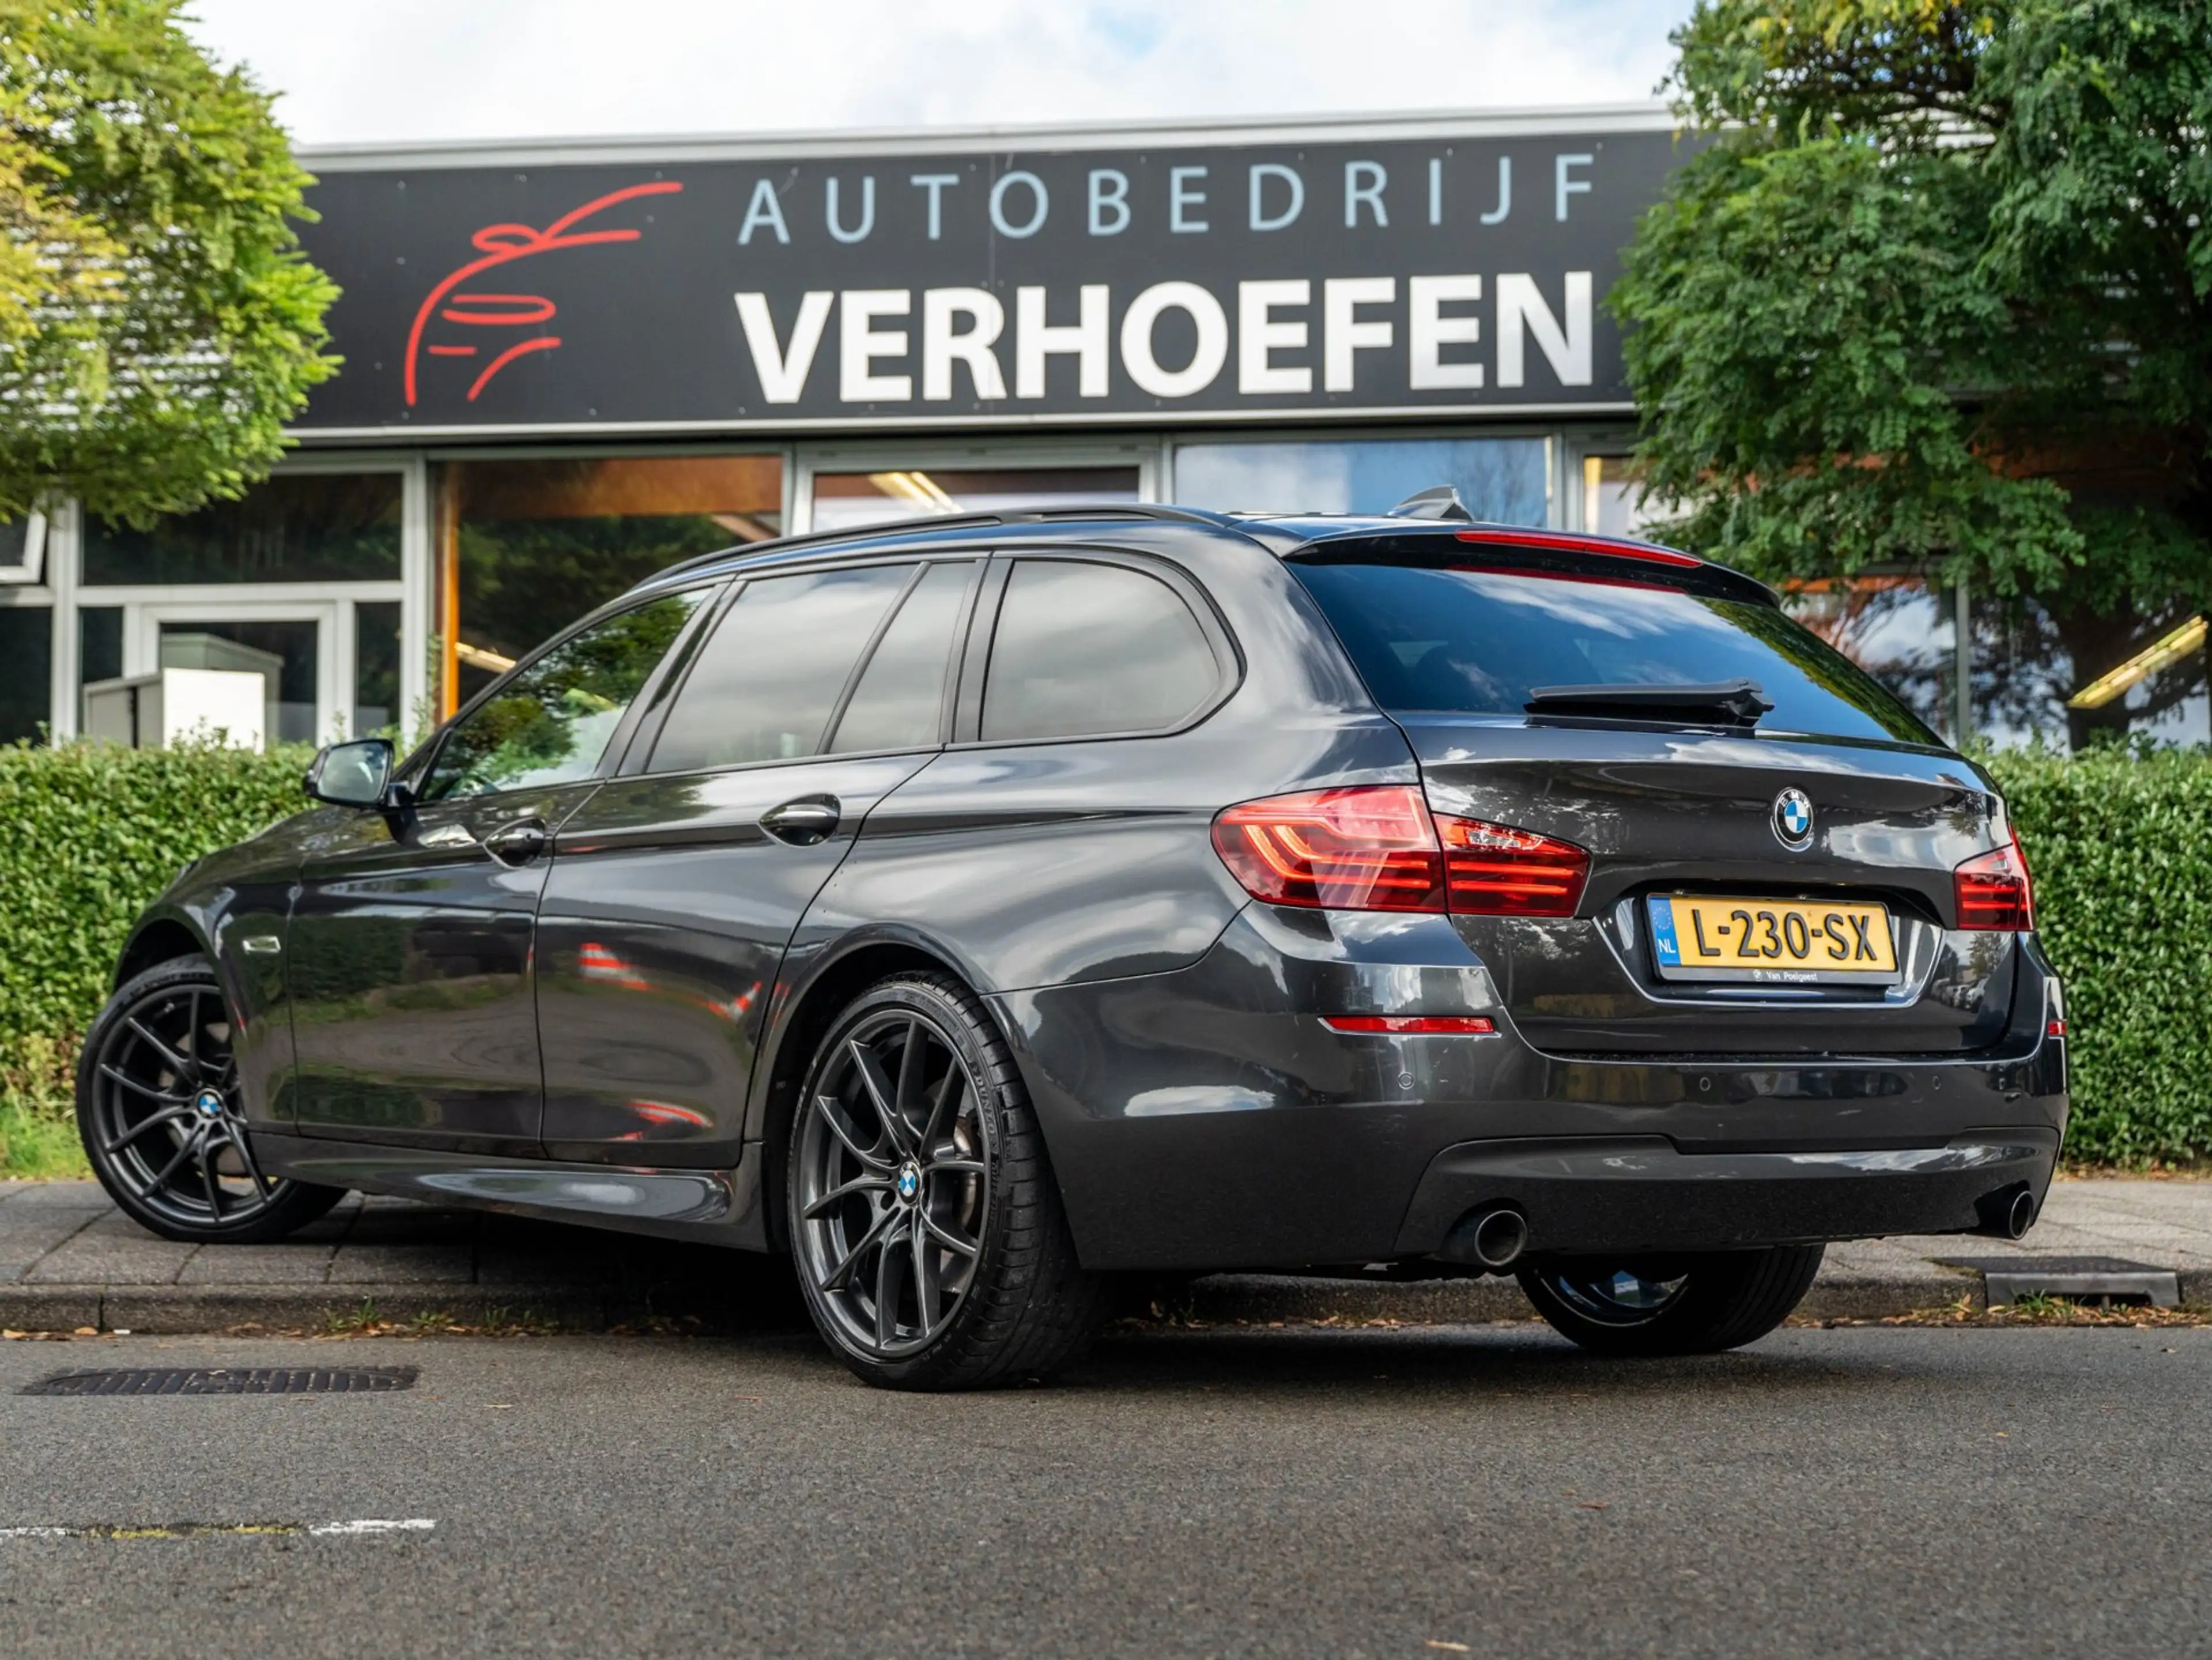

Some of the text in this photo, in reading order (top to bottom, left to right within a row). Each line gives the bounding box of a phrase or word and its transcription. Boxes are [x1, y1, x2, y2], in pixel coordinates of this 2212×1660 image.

[737, 154, 1594, 244] AUTOBEDRIJF
[734, 271, 1592, 403] VERHOEFEN
[1779, 790, 1810, 809] BMW
[1658, 938, 1676, 953] NL
[1692, 908, 1877, 961] L-230-SX
